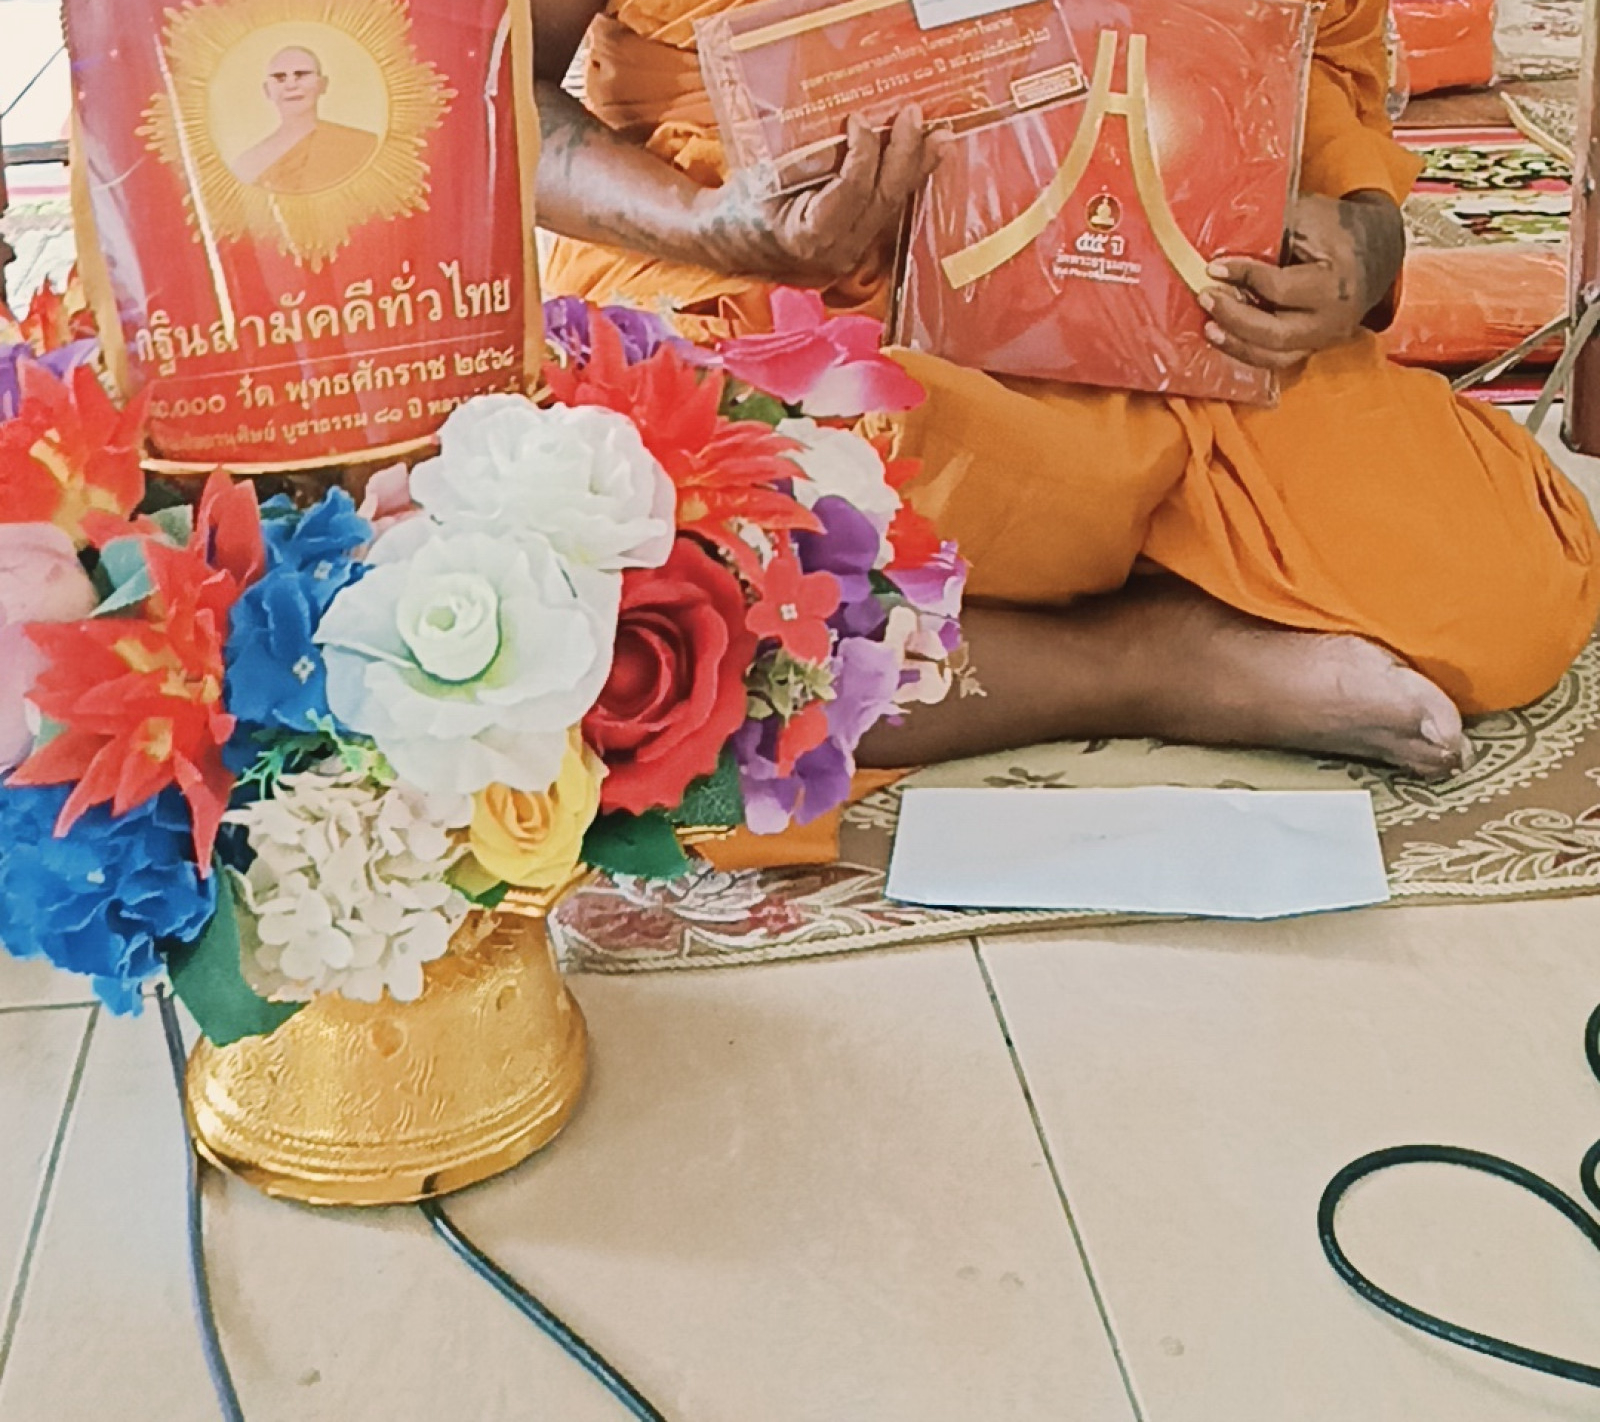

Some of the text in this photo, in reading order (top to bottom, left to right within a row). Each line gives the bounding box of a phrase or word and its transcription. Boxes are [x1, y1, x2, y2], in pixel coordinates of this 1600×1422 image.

[135, 260, 513, 376] กฐินสามัคคีทั่วไทย
[236, 374, 275, 410] วัด
[284, 357, 447, 411] พุทธศักราช
[282, 411, 369, 446] บูชาธรรม
[407, 396, 423, 419] ปี
